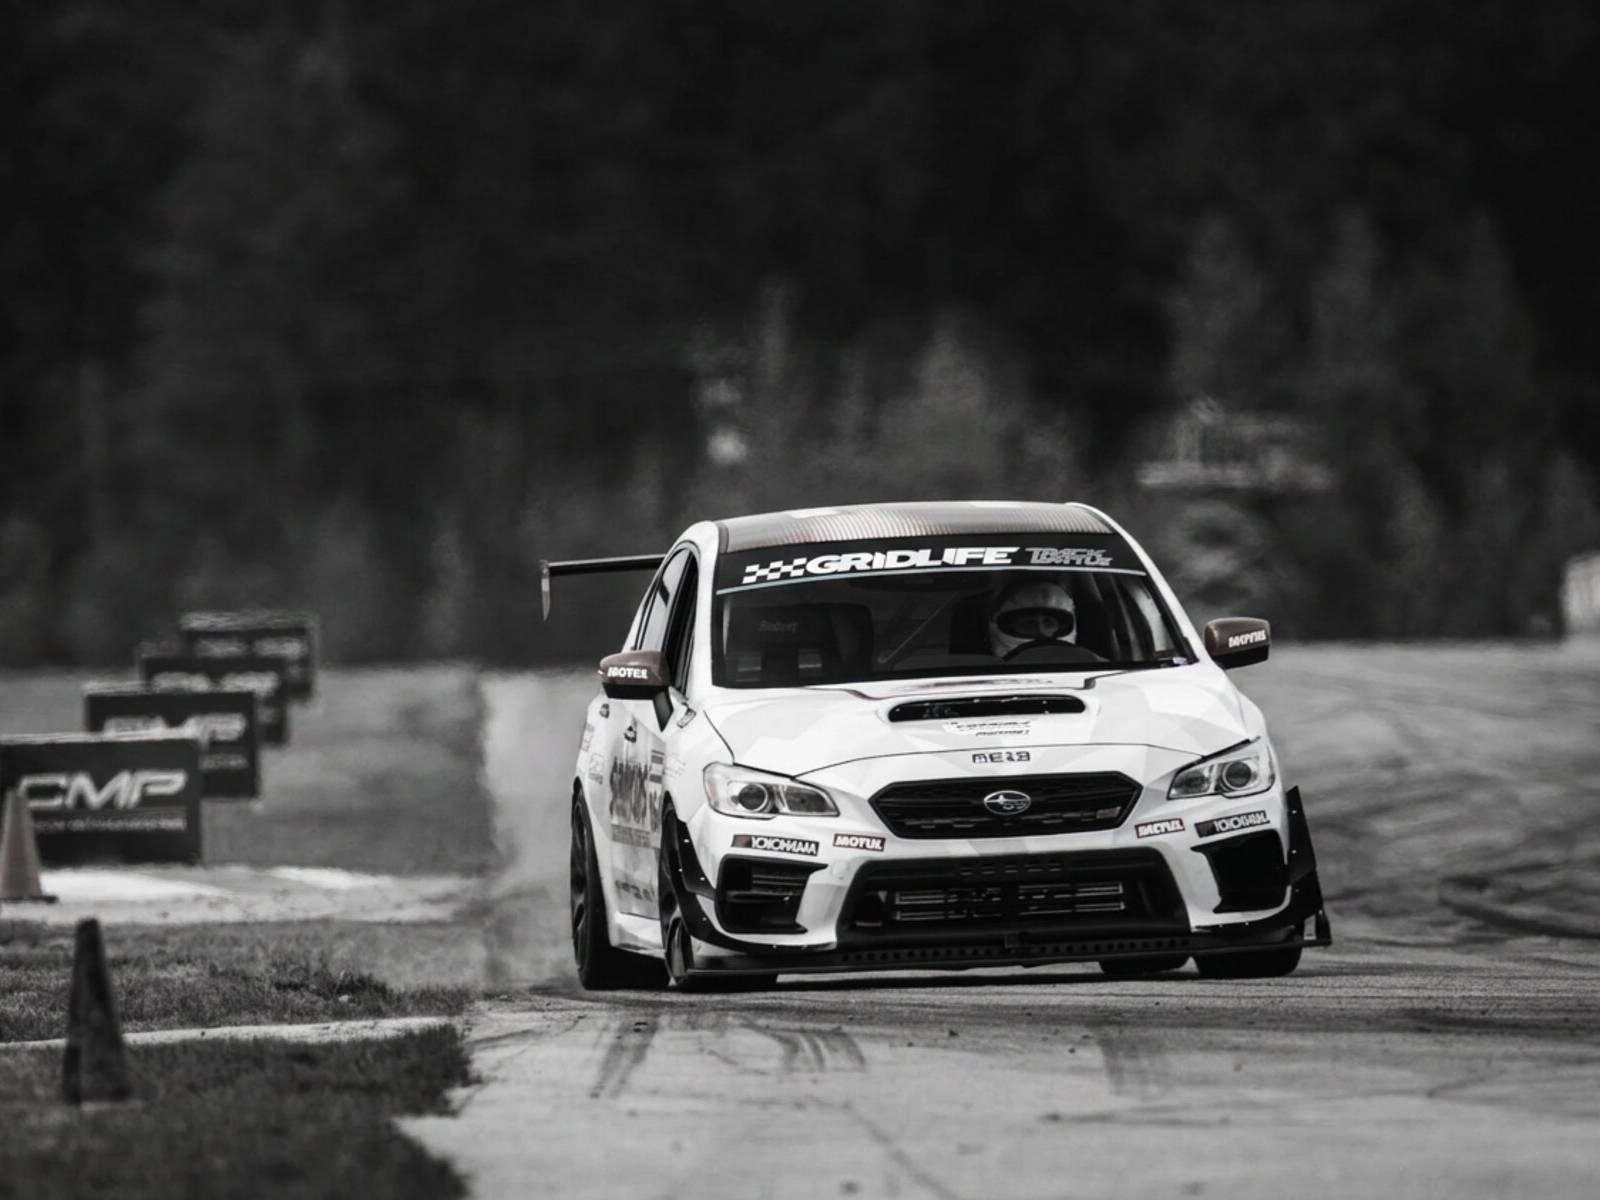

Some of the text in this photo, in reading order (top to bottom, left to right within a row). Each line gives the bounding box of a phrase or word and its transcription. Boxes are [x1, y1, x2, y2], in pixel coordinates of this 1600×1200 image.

[806, 547, 1020, 574] GRIDLIFE
[18, 770, 188, 809] CMP
[835, 835, 883, 850] MOTUL
